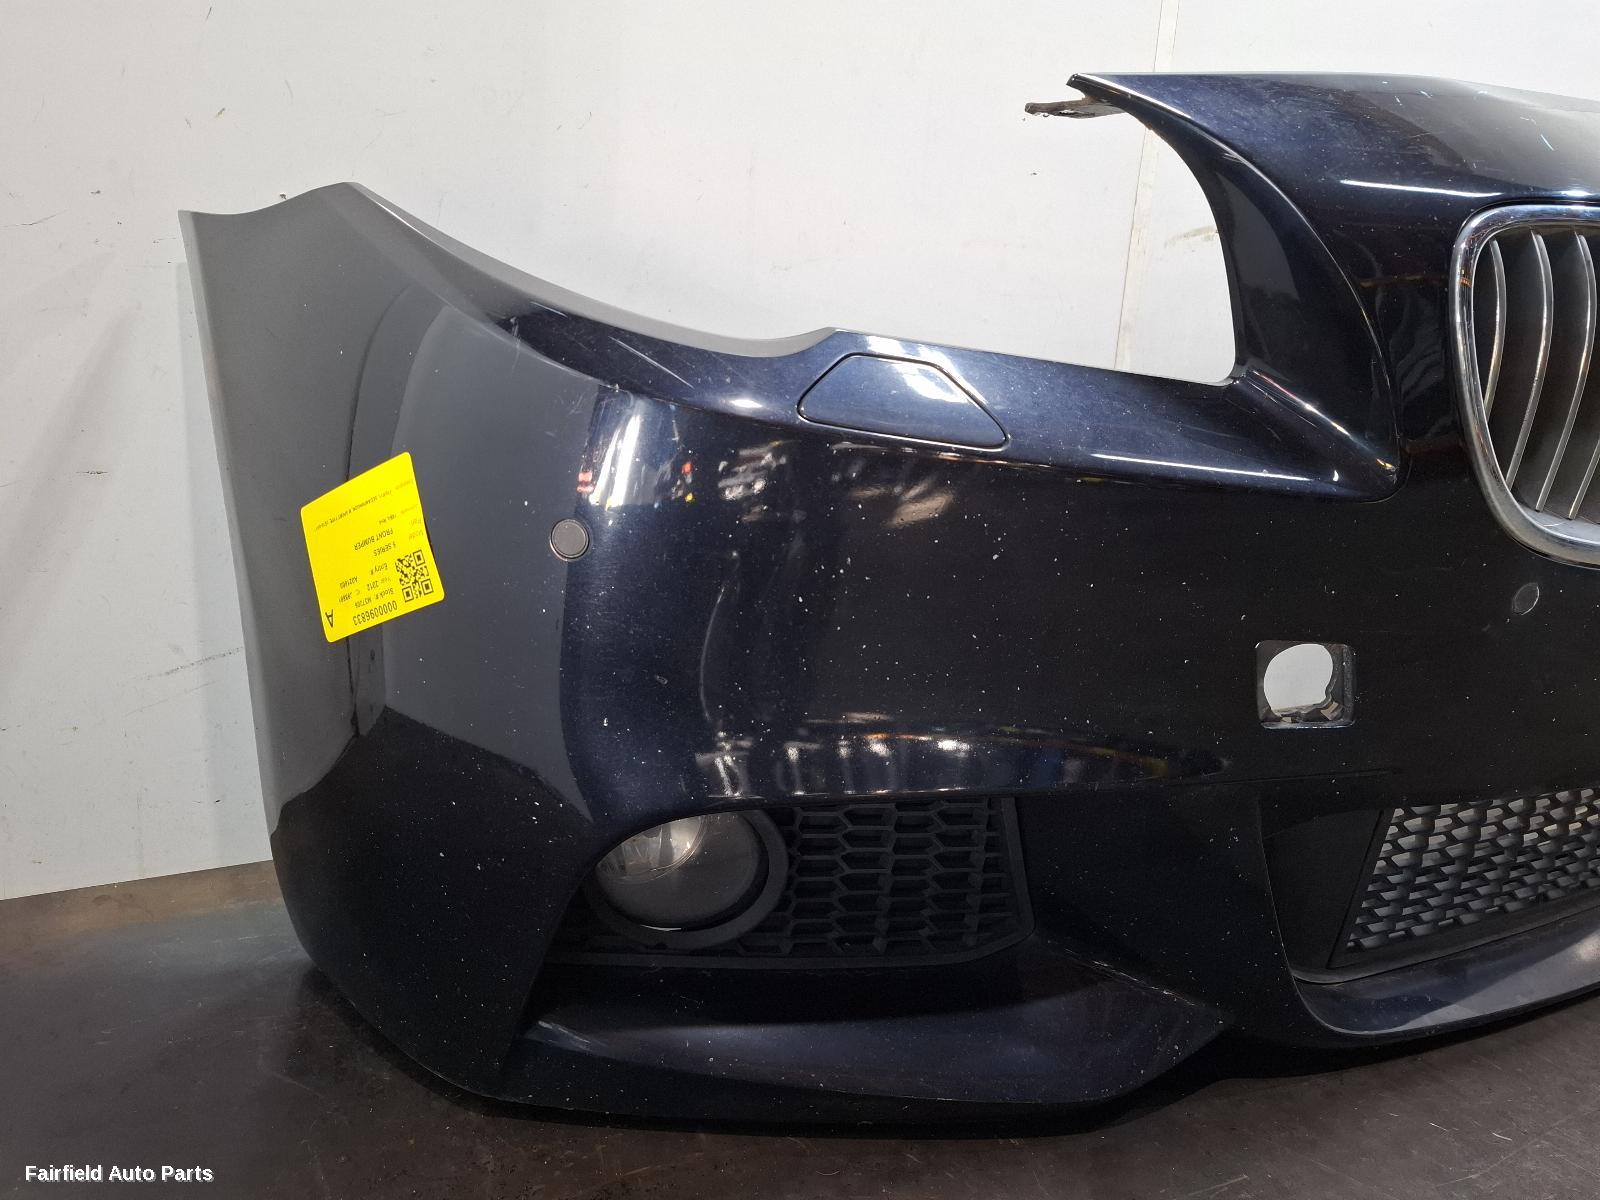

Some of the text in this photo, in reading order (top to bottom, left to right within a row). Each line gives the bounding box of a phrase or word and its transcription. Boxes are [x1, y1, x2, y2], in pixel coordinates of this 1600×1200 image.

[375, 526, 393, 540] FRONT
[353, 535, 374, 550] BUMPER
[372, 542, 391, 556] SERIES
[324, 609, 336, 629] A
[352, 599, 397, 626] 0000096833
